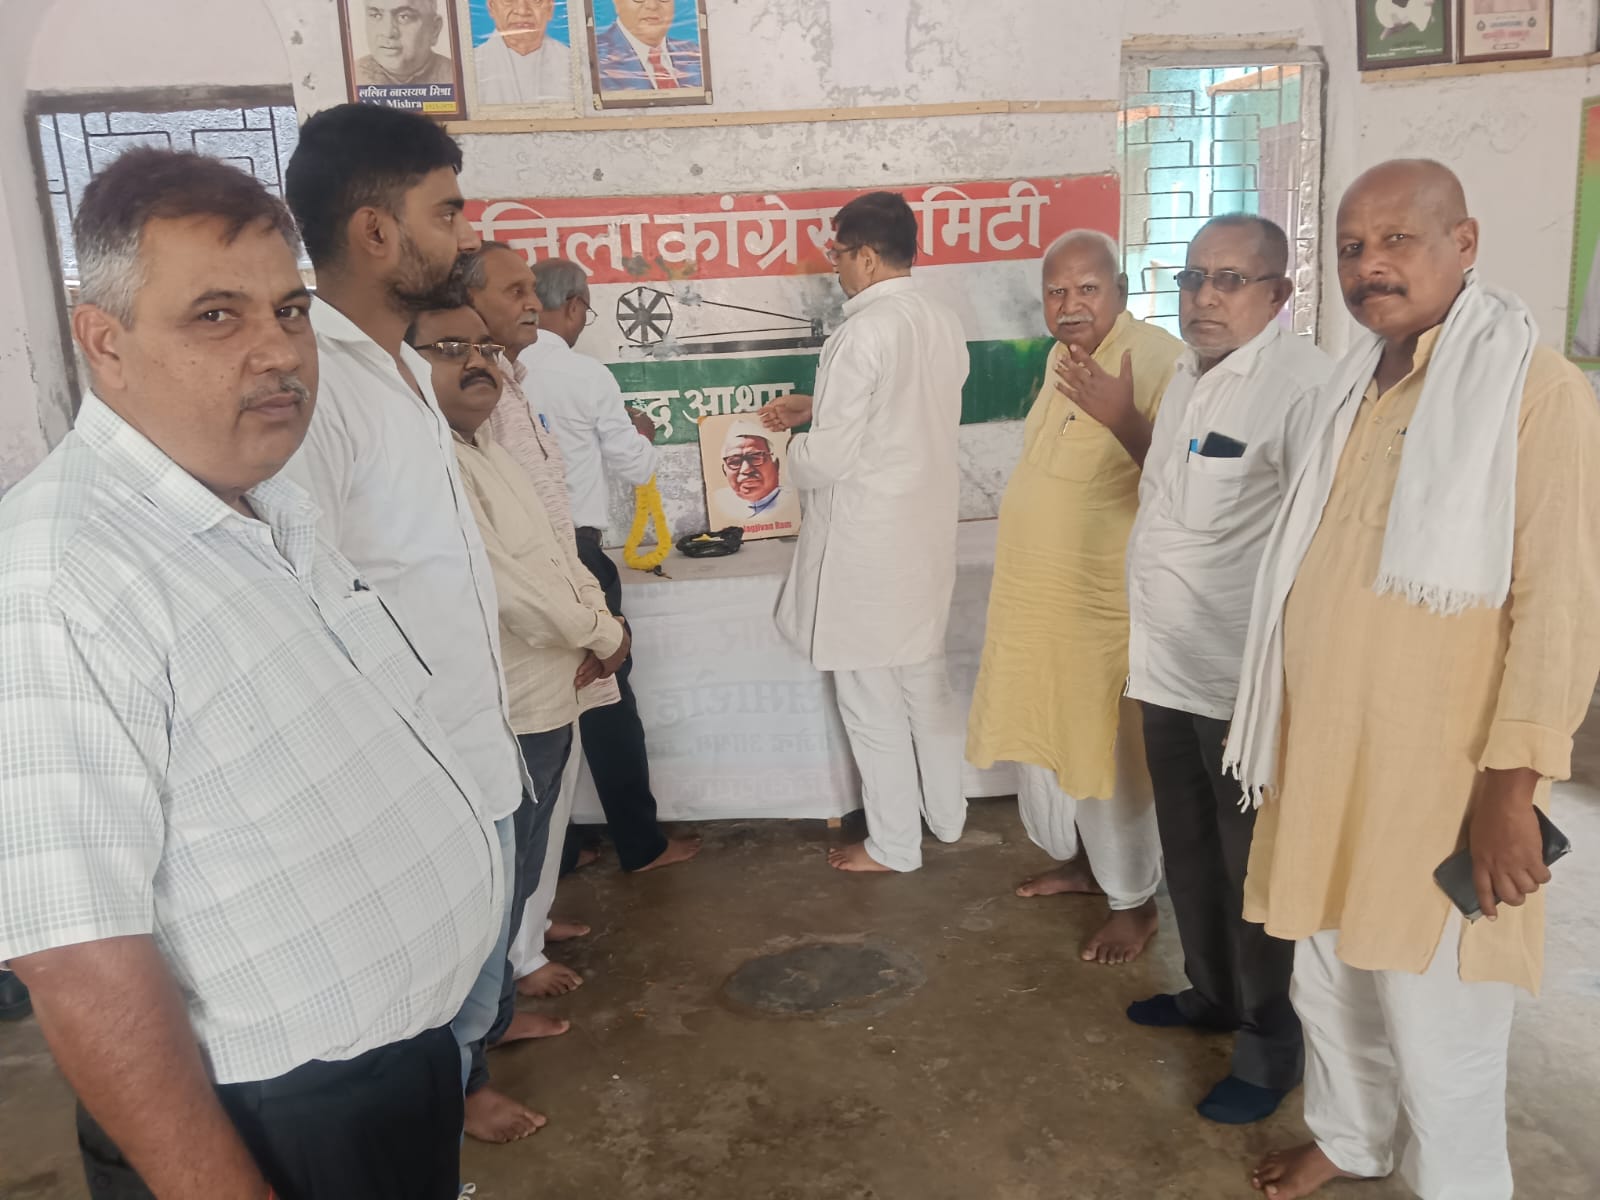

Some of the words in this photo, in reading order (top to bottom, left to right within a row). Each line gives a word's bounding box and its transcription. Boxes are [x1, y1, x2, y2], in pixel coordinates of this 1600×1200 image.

[359, 85, 387, 97] ललित
[389, 86, 427, 97] नारायण
[429, 84, 451, 96] मिश्रा
[386, 99, 422, 108] Mishra
[911, 181, 1050, 257] मिटी
